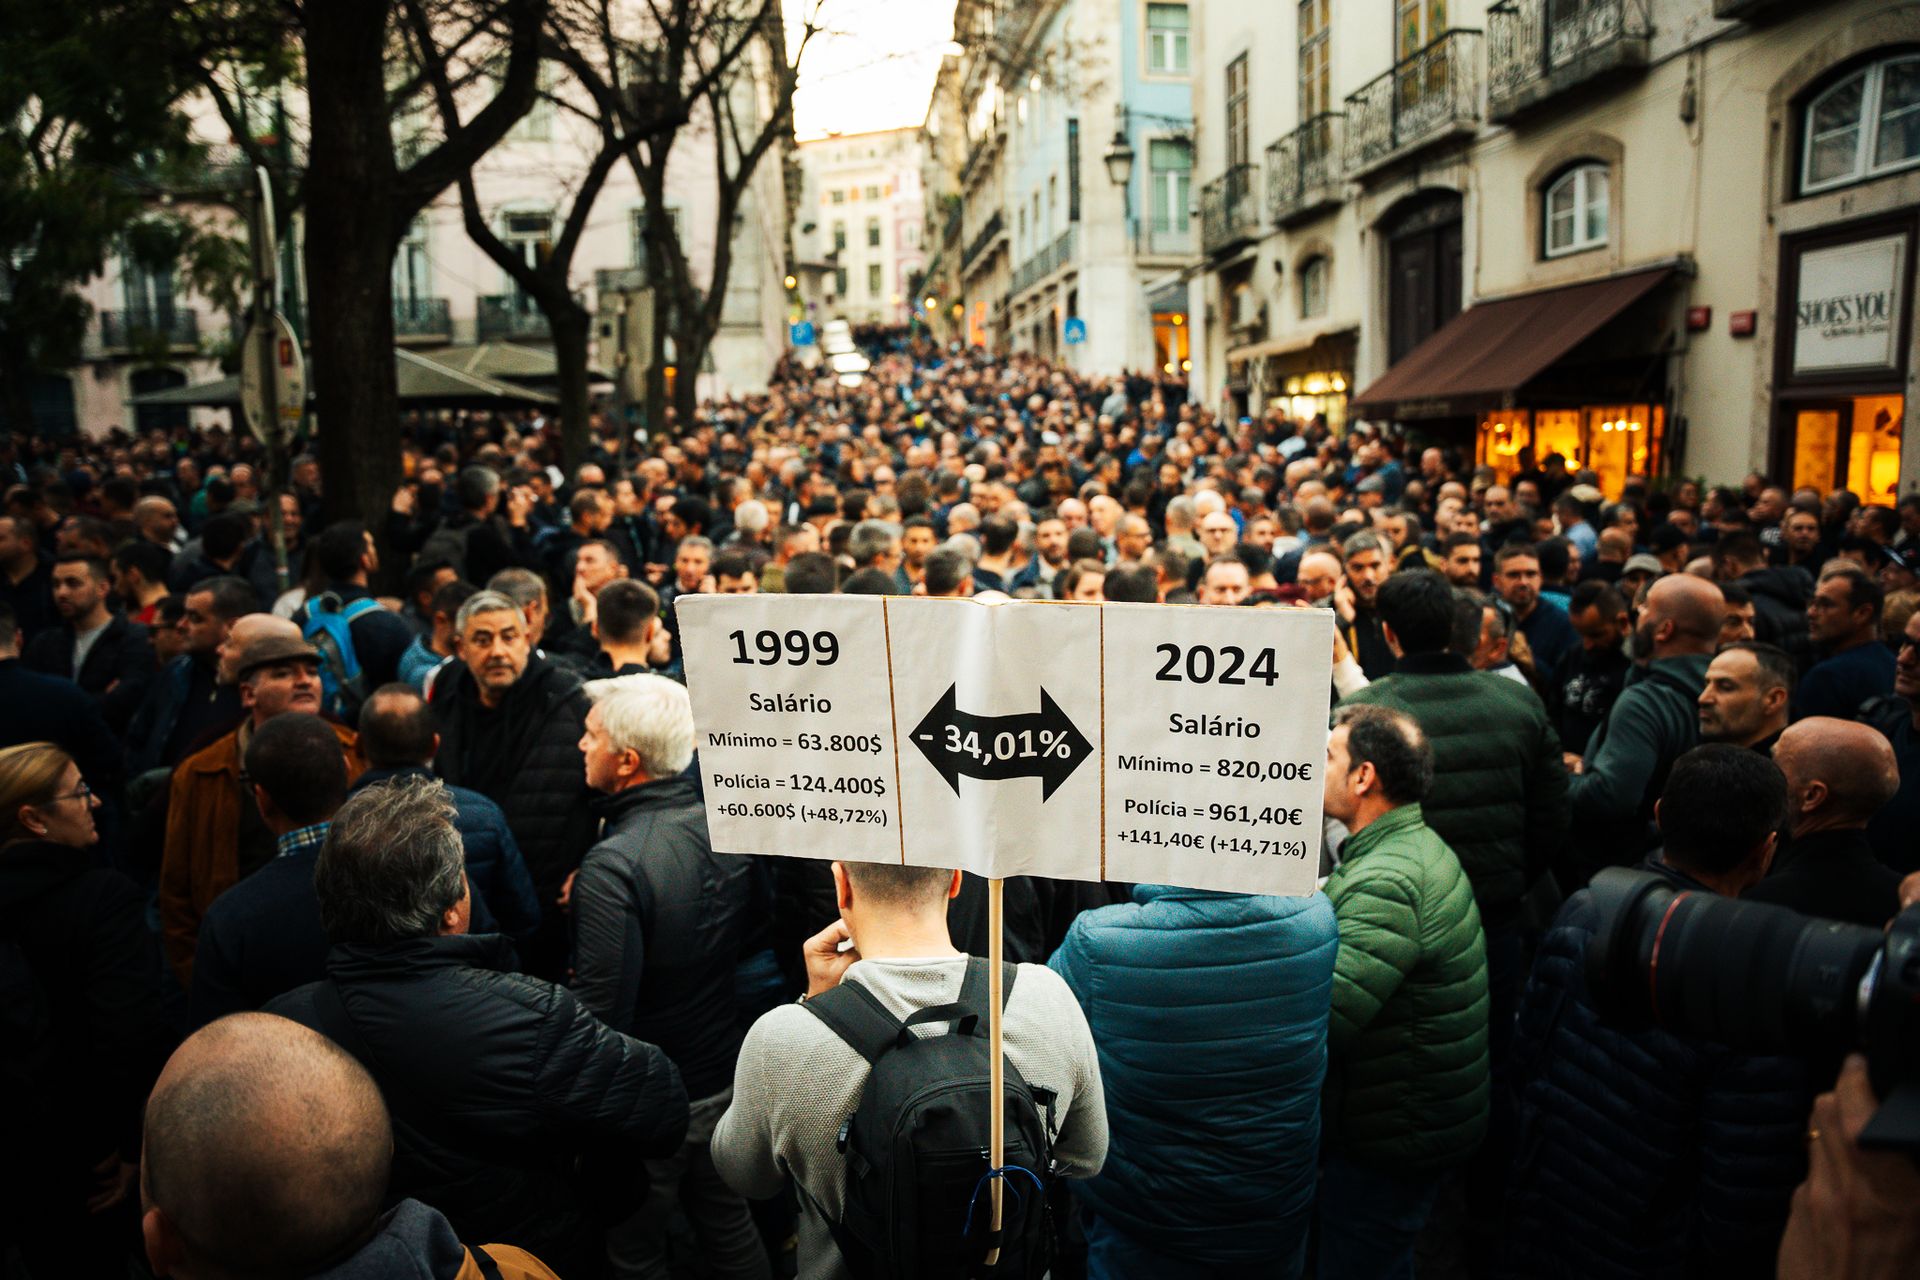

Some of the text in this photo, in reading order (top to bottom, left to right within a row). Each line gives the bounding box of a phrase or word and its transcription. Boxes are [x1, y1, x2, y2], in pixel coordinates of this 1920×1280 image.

[1797, 295, 1850, 330] SHOES
[1855, 290, 1889, 322] YOU
[729, 629, 840, 667] 1999
[1155, 642, 1280, 687] 2024
[749, 692, 832, 714] Salário
[1169, 712, 1261, 739] Salário
[708, 732, 882, 756] Mínimo = 63.800$
[944, 724, 1071, 767] 34,01%
[1118, 755, 1313, 783] Mínimo = 820,00€
[713, 773, 886, 797] Polícia = 124.400$
[717, 802, 888, 827] +60.600$ (+48,72%)
[1124, 798, 1303, 827] Polícia = 961,40€
[1117, 829, 1307, 860] +141,40€ (+14,71%)
